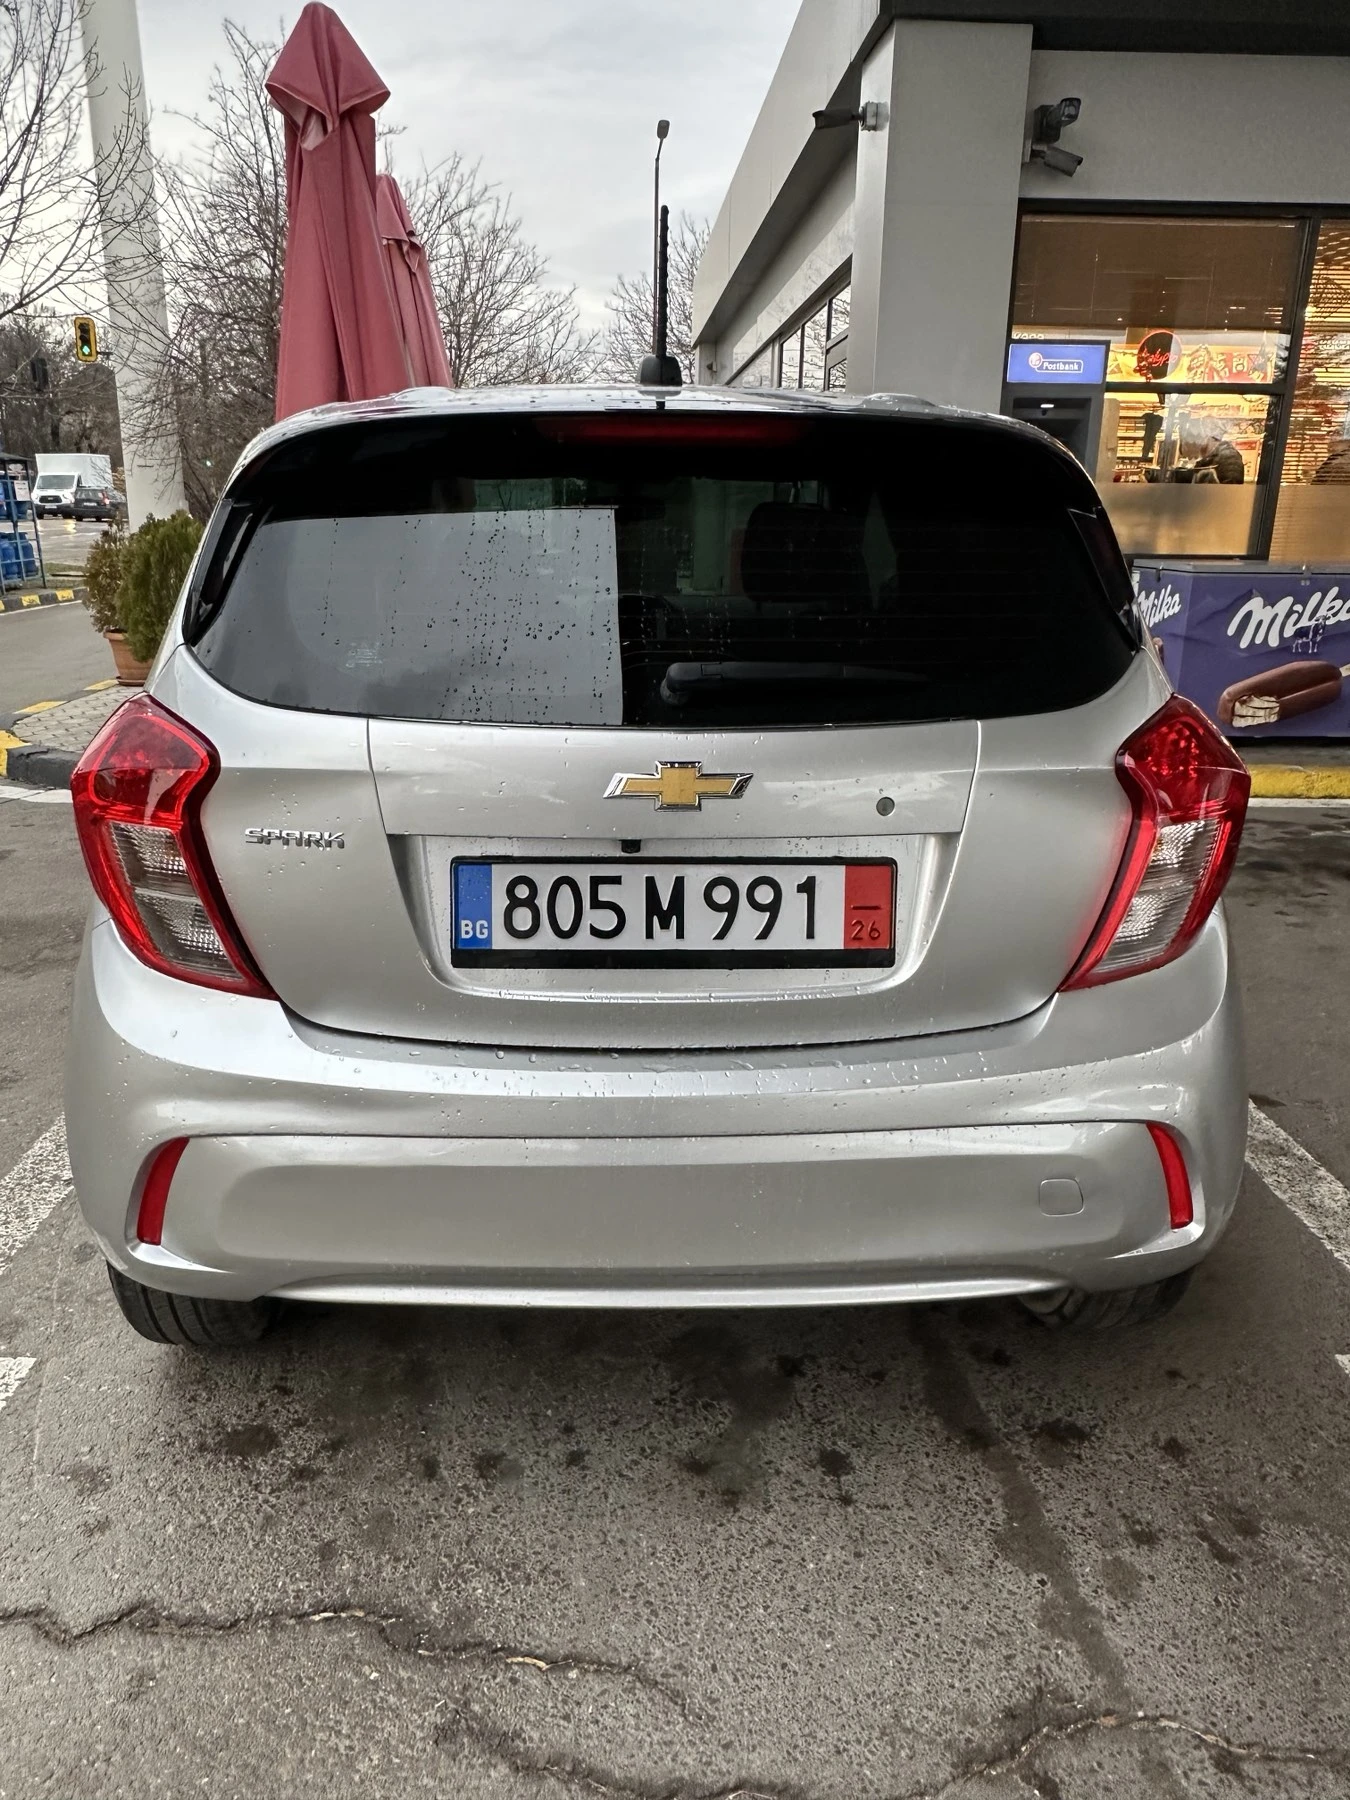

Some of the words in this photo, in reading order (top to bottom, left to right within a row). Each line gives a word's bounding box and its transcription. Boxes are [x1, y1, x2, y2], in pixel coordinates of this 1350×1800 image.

[1042, 361, 1079, 371] Postbank
[1138, 584, 1181, 628] Milka
[245, 828, 345, 850] SPARK
[503, 875, 627, 940] 805
[645, 876, 685, 940] M
[703, 875, 817, 941] 991
[461, 919, 488, 939] BG
[851, 919, 880, 941] 26
